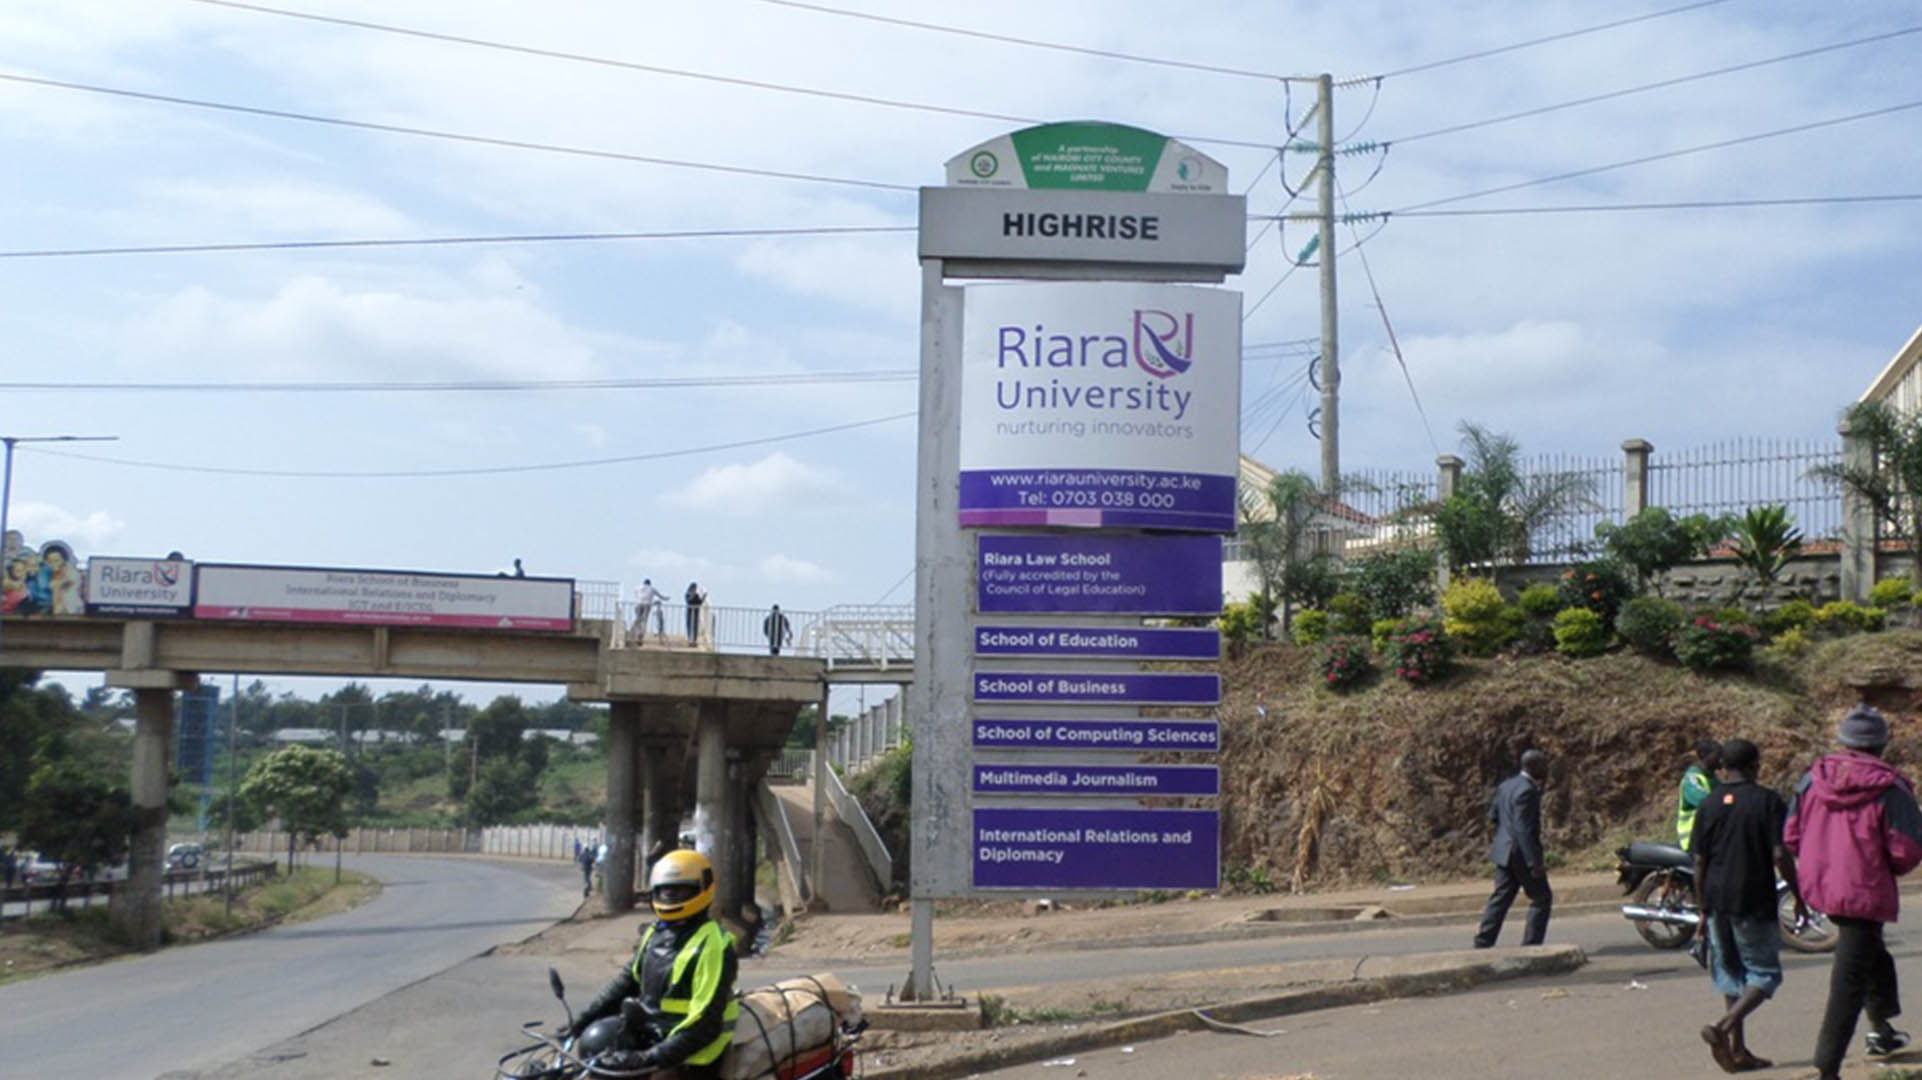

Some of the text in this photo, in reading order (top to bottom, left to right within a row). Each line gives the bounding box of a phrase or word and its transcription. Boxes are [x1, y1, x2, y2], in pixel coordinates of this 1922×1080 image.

[1003, 212, 1159, 240] HIGHRISE
[998, 324, 1128, 368] Riara
[997, 379, 1191, 420] University
[997, 420, 1194, 439] nurturing innovators
[991, 470, 1201, 491] www.riarauniversity.ac.ke
[1018, 490, 1175, 508] Tel: 0703 038 000
[984, 553, 1111, 566] Riara Law School
[101, 565, 152, 584] Riara
[982, 570, 1120, 582] (Fully accredited by the
[101, 586, 177, 601] University
[986, 583, 1146, 597] Council of Legal Education)
[980, 632, 1138, 648] School of Education
[979, 679, 1126, 695] School of Business
[977, 726, 1216, 744] School of Computing Sciences
[979, 771, 1158, 786] Multimedia Journalism
[979, 829, 1192, 844] International Relations and
[979, 848, 1064, 864] Diplomacy
